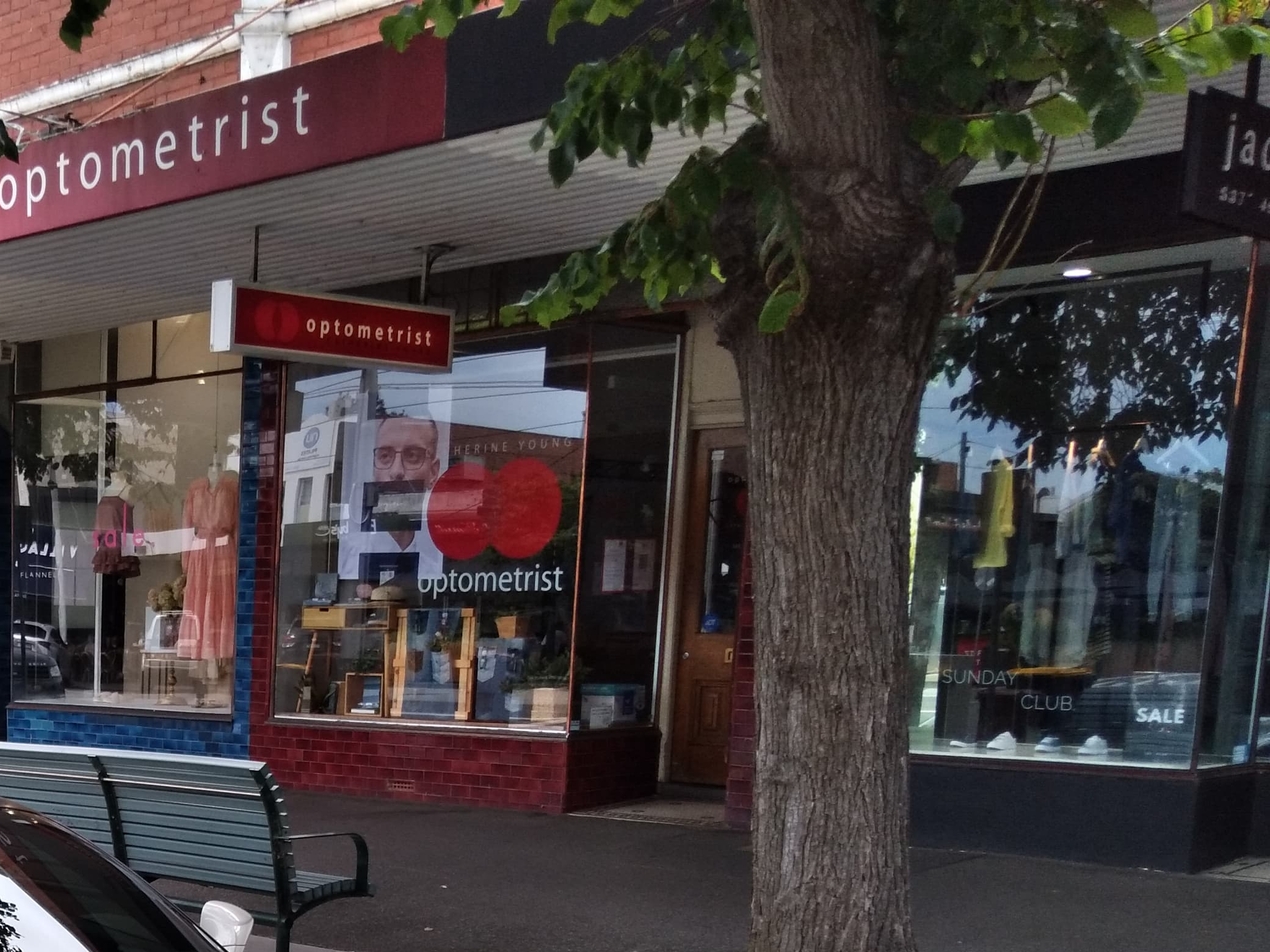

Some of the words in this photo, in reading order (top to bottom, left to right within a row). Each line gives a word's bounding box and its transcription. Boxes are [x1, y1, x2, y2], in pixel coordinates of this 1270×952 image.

[306, 317, 432, 347] optometrist
[518, 437, 572, 450] YOUNG
[417, 564, 564, 600] optometrist
[942, 669, 1020, 686] SUNDAY
[1020, 694, 1073, 712] CLUB
[1136, 707, 1185, 724] SALE
